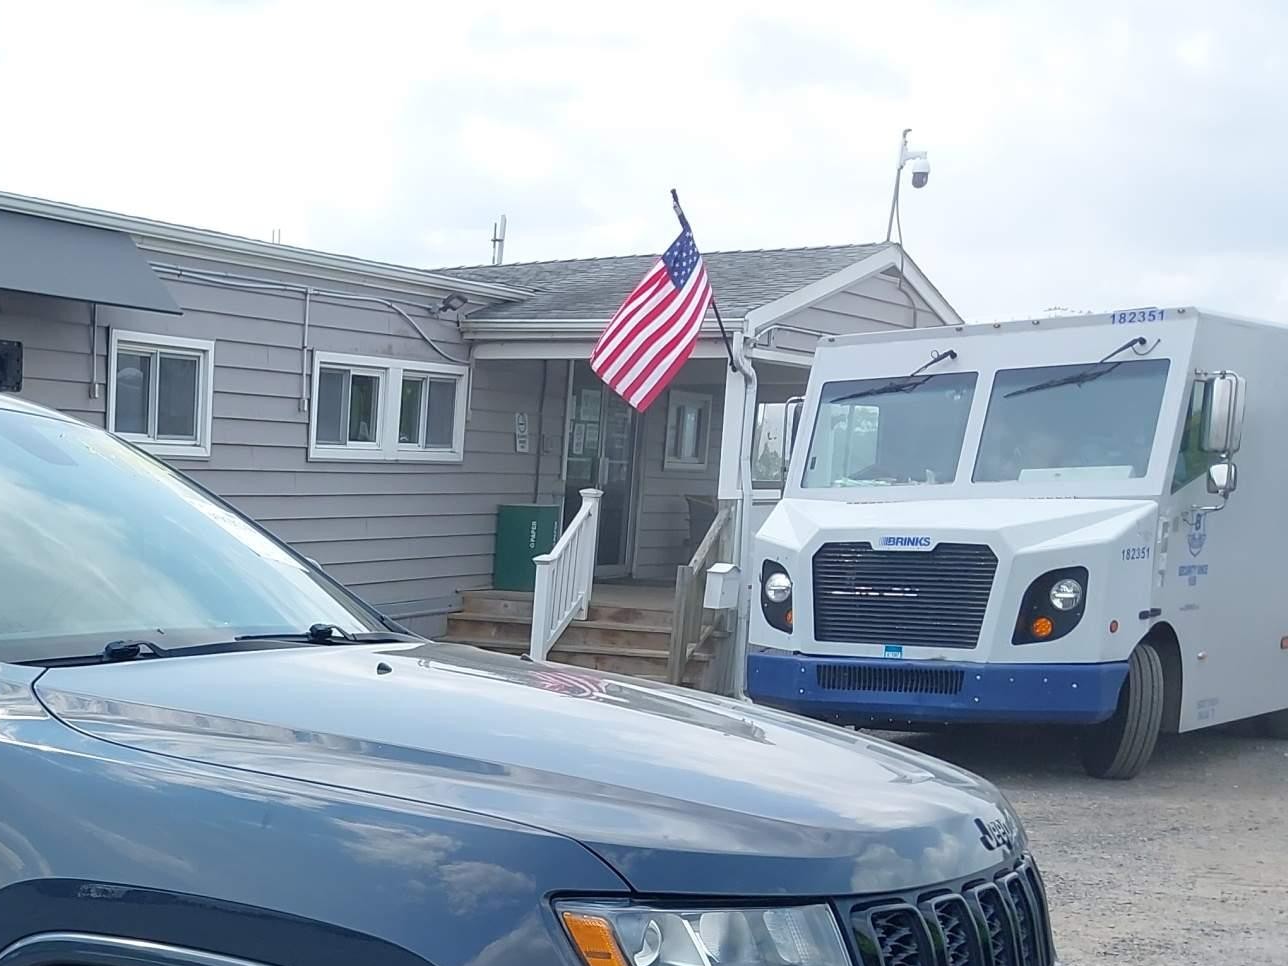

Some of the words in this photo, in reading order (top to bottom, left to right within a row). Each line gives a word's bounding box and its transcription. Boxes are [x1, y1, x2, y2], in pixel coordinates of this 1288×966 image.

[1111, 310, 1165, 325] 182351
[887, 536, 931, 547] BRINKS
[1122, 546, 1150, 560] 182351
